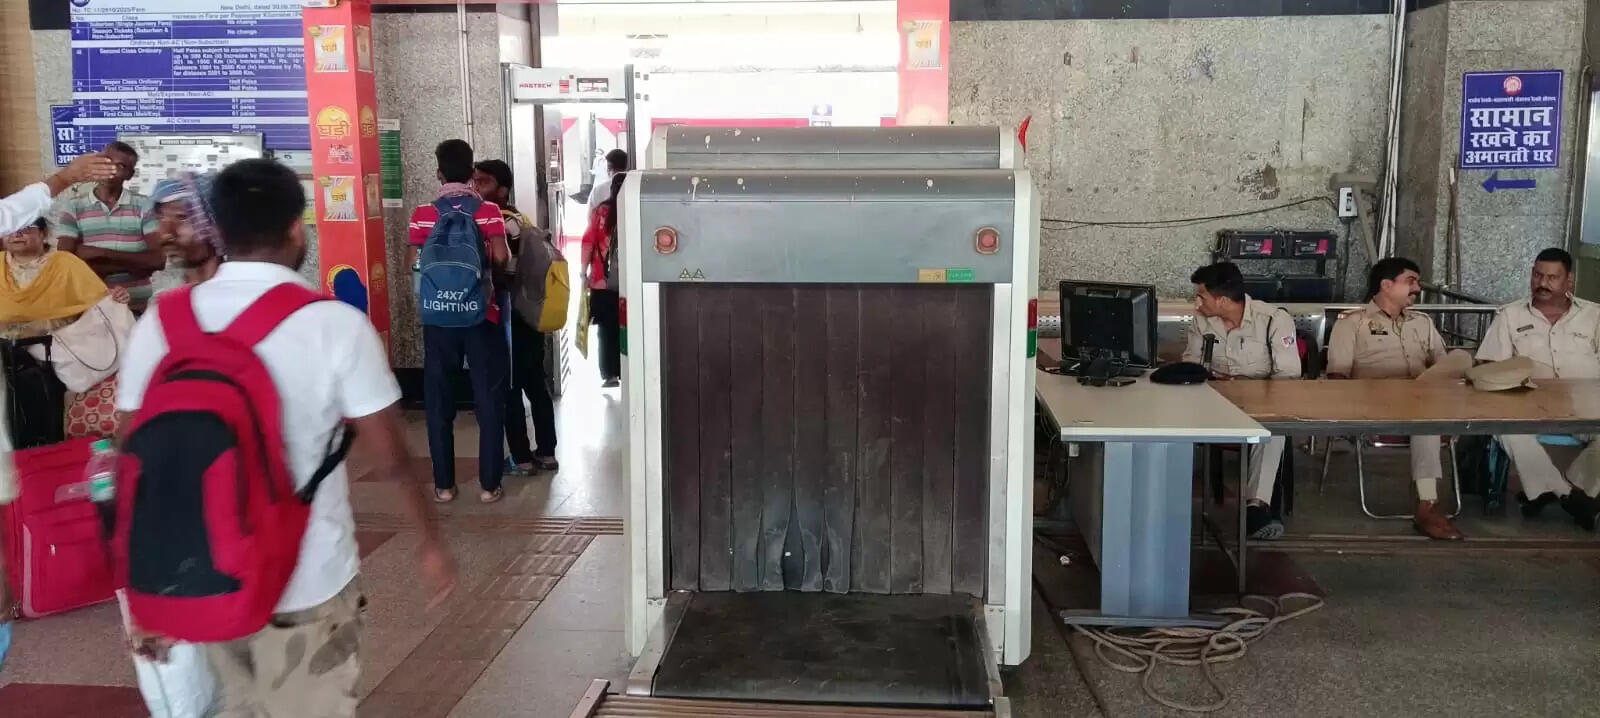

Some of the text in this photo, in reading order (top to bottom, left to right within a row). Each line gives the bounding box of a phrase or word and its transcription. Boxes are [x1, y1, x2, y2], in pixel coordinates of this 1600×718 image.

[1470, 107, 1553, 127] सामान
[1470, 127, 1551, 147] रखने का
[1465, 147, 1553, 163] अमानती घर
[437, 290, 464, 300] 24X7
[423, 299, 478, 312] LIGHTING
